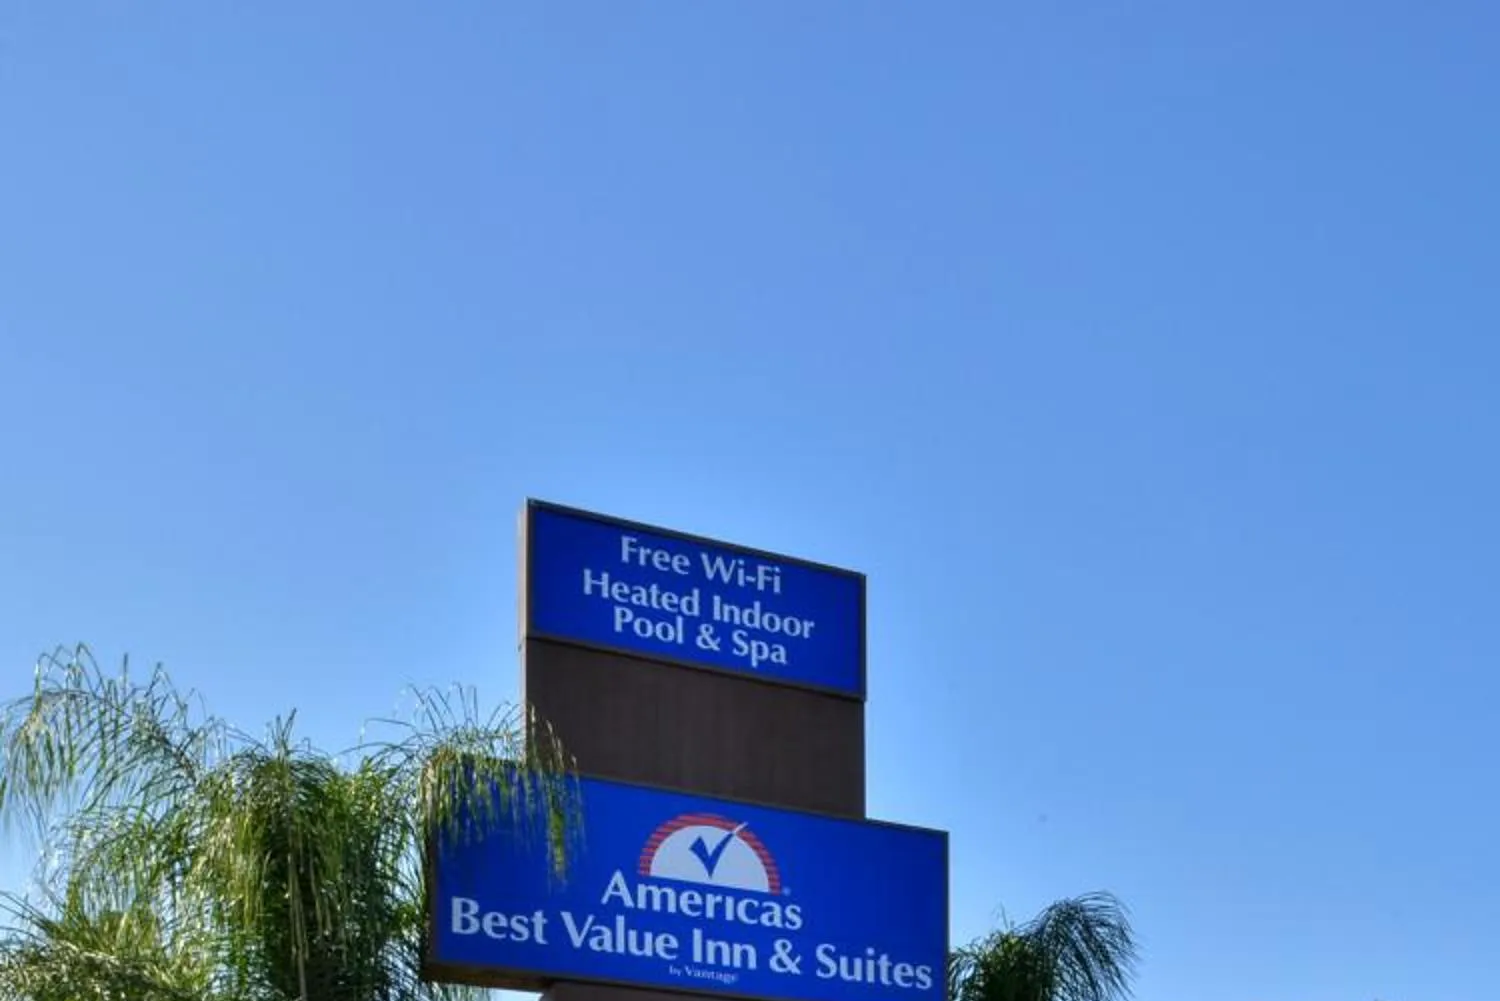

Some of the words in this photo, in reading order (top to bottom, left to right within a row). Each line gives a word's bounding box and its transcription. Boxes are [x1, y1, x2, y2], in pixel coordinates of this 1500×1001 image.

[621, 535, 691, 575] Free
[700, 552, 782, 594] Wi-Fi
[583, 568, 700, 617] Heated
[712, 595, 815, 638] Indoor
[613, 606, 684, 644] Pool
[695, 623, 721, 651] &
[732, 629, 787, 668] Spa
[601, 869, 803, 931] Americas
[451, 896, 548, 945] Best
[560, 911, 680, 960] Value
[692, 928, 757, 970] Inn
[769, 938, 802, 975] &
[815, 943, 933, 990] Suites
[684, 964, 738, 985] Vantage
